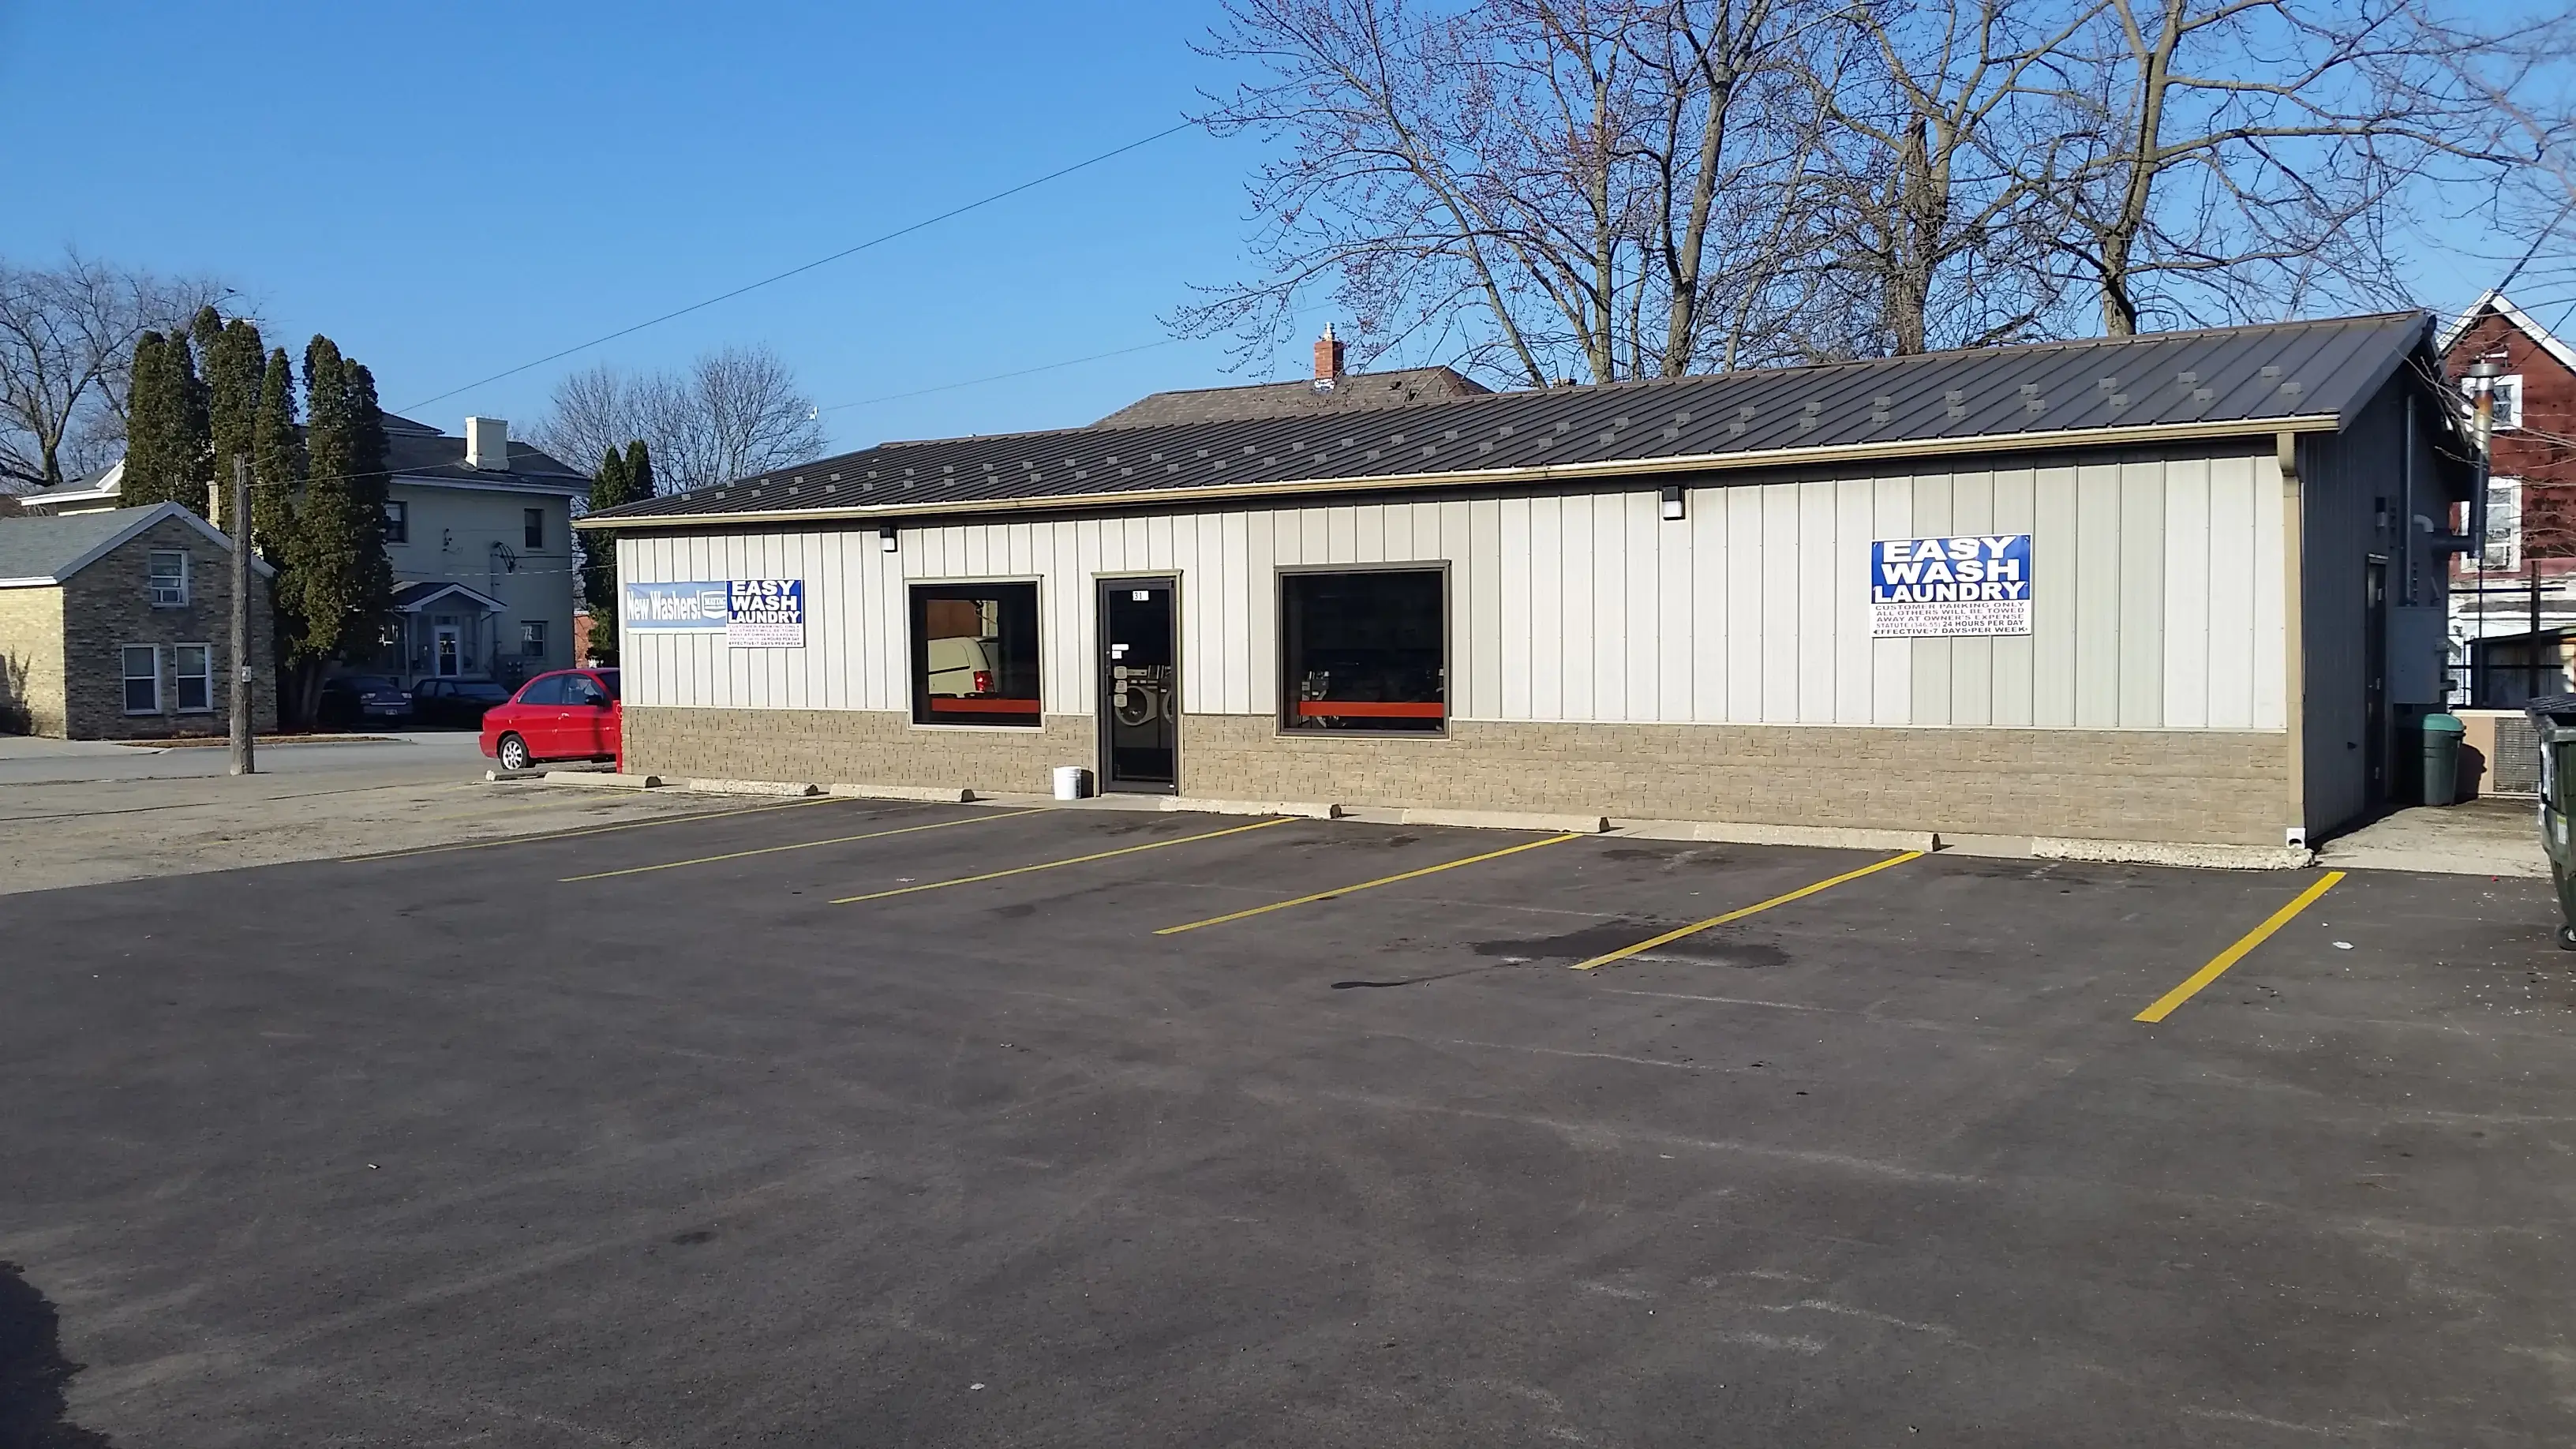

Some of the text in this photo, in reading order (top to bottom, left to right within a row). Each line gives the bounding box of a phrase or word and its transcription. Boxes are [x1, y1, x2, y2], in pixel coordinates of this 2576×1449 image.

[1883, 536, 2017, 563] EASY
[1881, 559, 2020, 585] WASH
[732, 580, 796, 596] EASY
[1874, 581, 2027, 604] LAUNDRY
[627, 590, 702, 620] New Washers!
[731, 595, 797, 611] WASH
[728, 610, 801, 623] LAUNDRY
